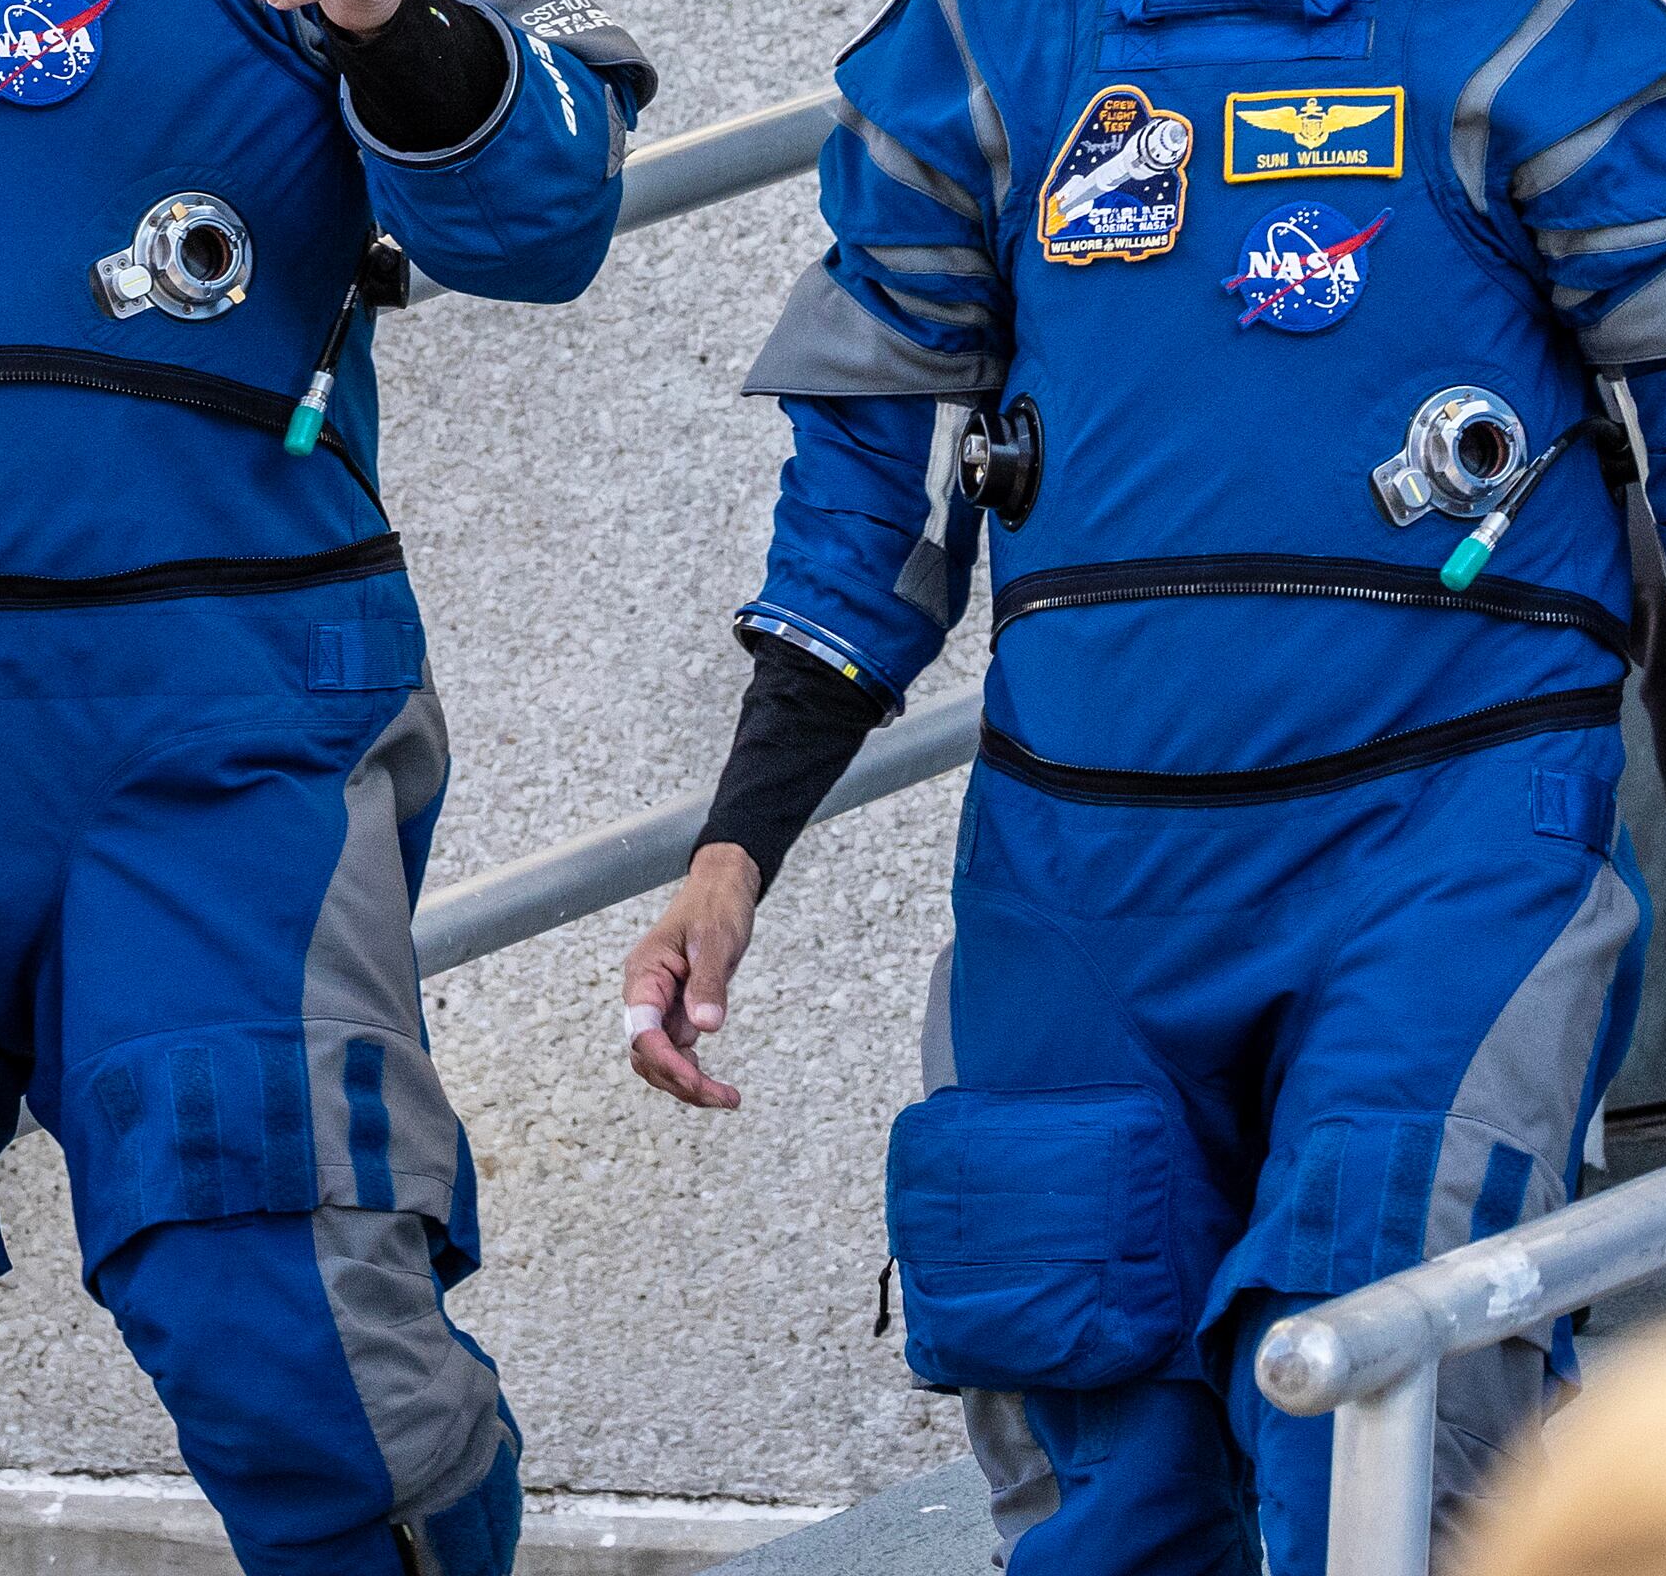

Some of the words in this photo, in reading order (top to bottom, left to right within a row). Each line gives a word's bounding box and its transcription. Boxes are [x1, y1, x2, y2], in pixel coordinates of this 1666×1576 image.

[1104, 100, 1137, 110] CREW
[1098, 110, 1138, 122] FLIGHT
[1103, 121, 1132, 134] TEST
[1256, 152, 1289, 169] SUNI
[1297, 150, 1369, 167] WILLIAMS
[1088, 205, 1176, 225] STARLINER
[1094, 223, 1134, 234] BOEING
[1139, 221, 1167, 232] NASA
[1051, 239, 1103, 254] WILMORE
[1115, 235, 1169, 249] WILLIAMS
[1246, 251, 1360, 282] NASA
